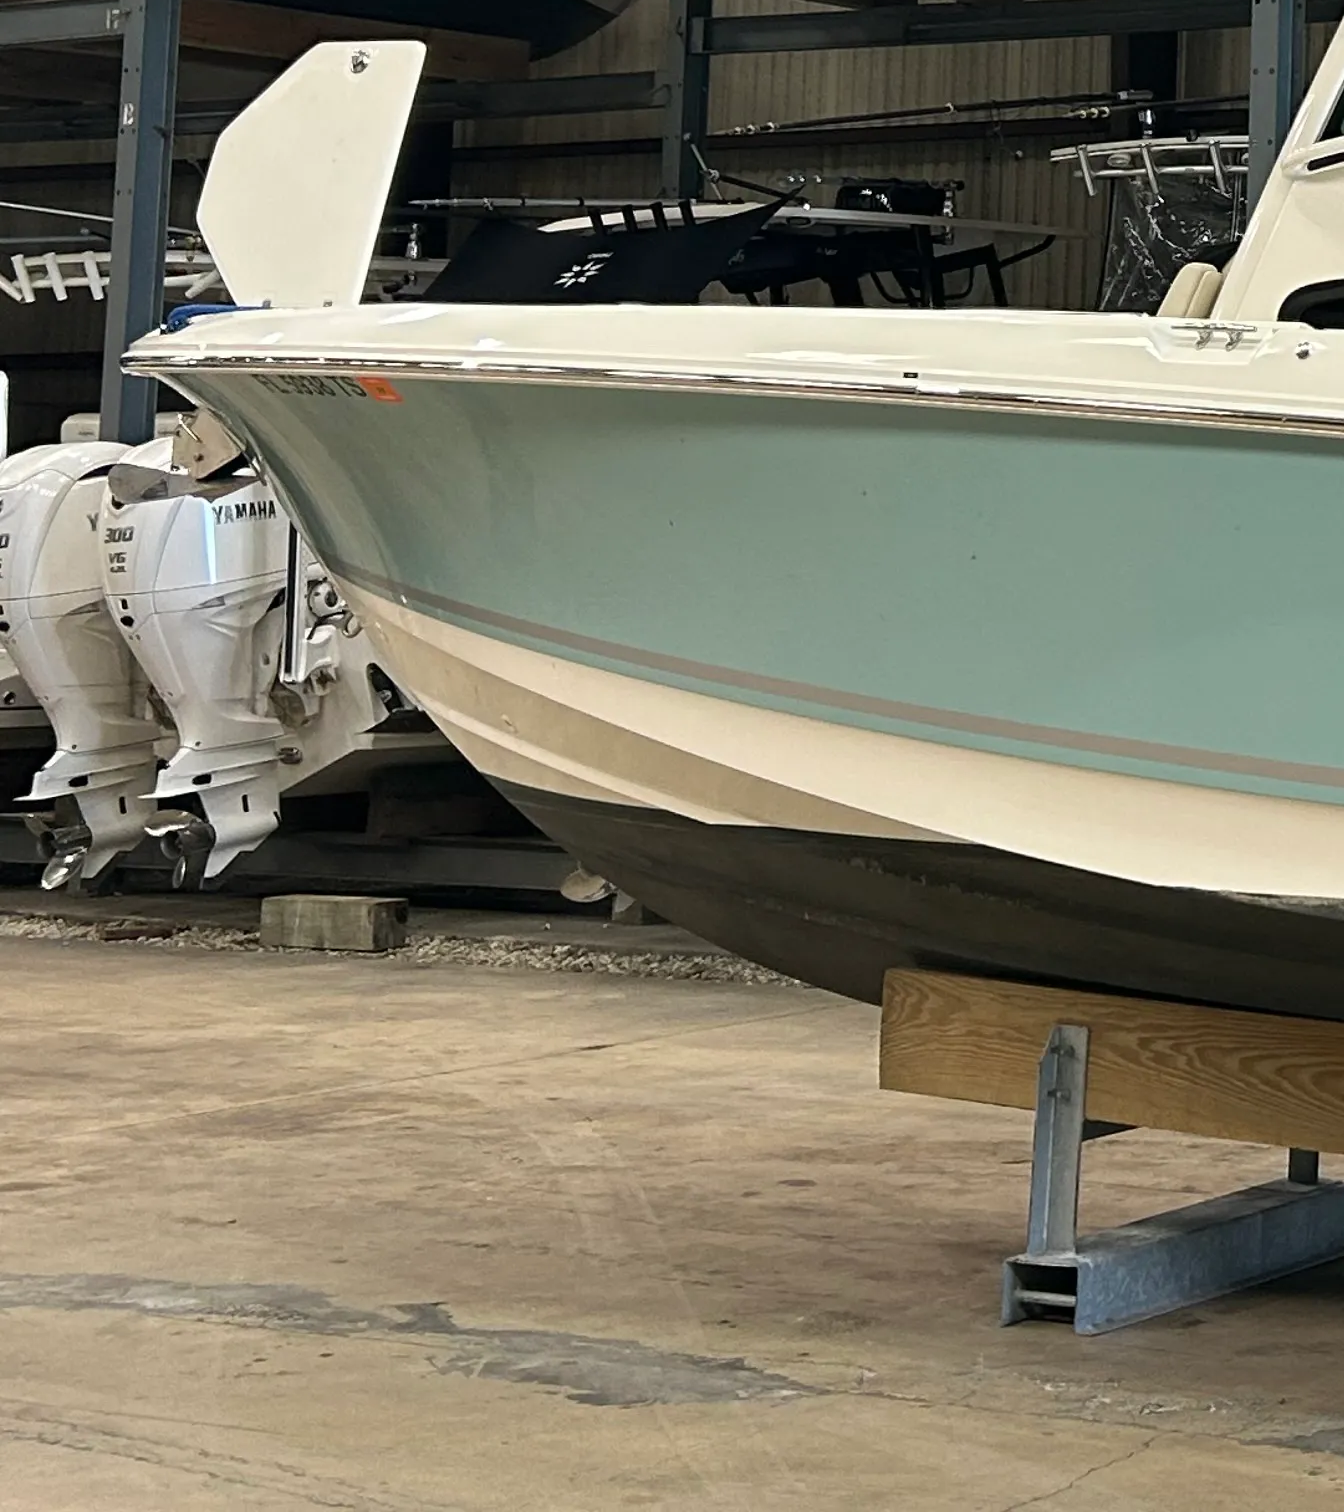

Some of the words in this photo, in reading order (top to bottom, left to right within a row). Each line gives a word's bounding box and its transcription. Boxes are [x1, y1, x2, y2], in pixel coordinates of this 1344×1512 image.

[106, 9, 120, 29] 17
[212, 500, 276, 525] YAMAHA
[104, 526, 134, 544] 300
[109, 552, 127, 564] V6
